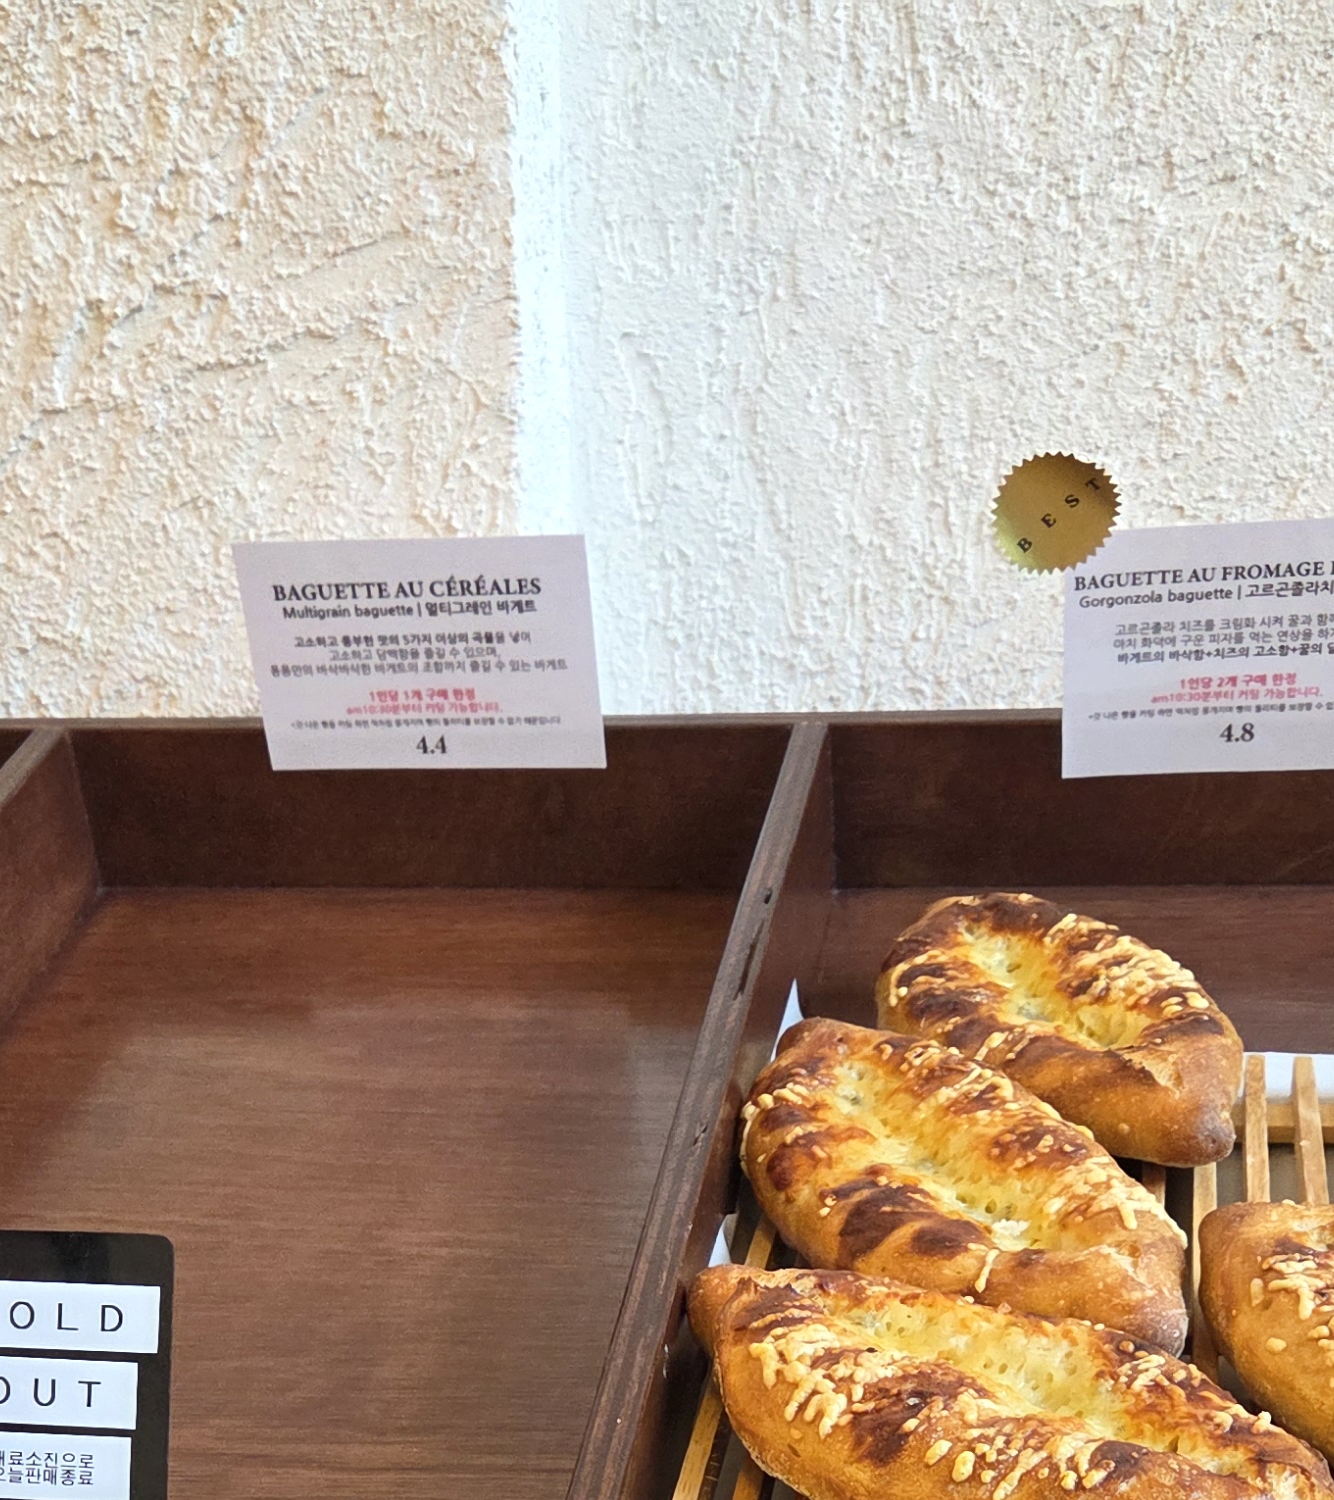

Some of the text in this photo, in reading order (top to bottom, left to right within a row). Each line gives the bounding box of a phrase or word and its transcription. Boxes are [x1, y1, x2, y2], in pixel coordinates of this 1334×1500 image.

[1016, 477, 1102, 554] BEST
[1074, 569, 1183, 591] BAGUETTE
[1187, 567, 1216, 583] AU
[1221, 561, 1324, 581] FROMAGE
[272, 574, 541, 601] BAGUETTE AU CÉRÉALES
[1079, 590, 1163, 608] Gorgonzola
[1167, 588, 1233, 603] baguette
[282, 605, 351, 620] Multigrain
[354, 604, 413, 619] baguette
[496, 599, 536, 614] 바게트
[1220, 722, 1254, 742] 4.8
[416, 735, 446, 754] 4.4
